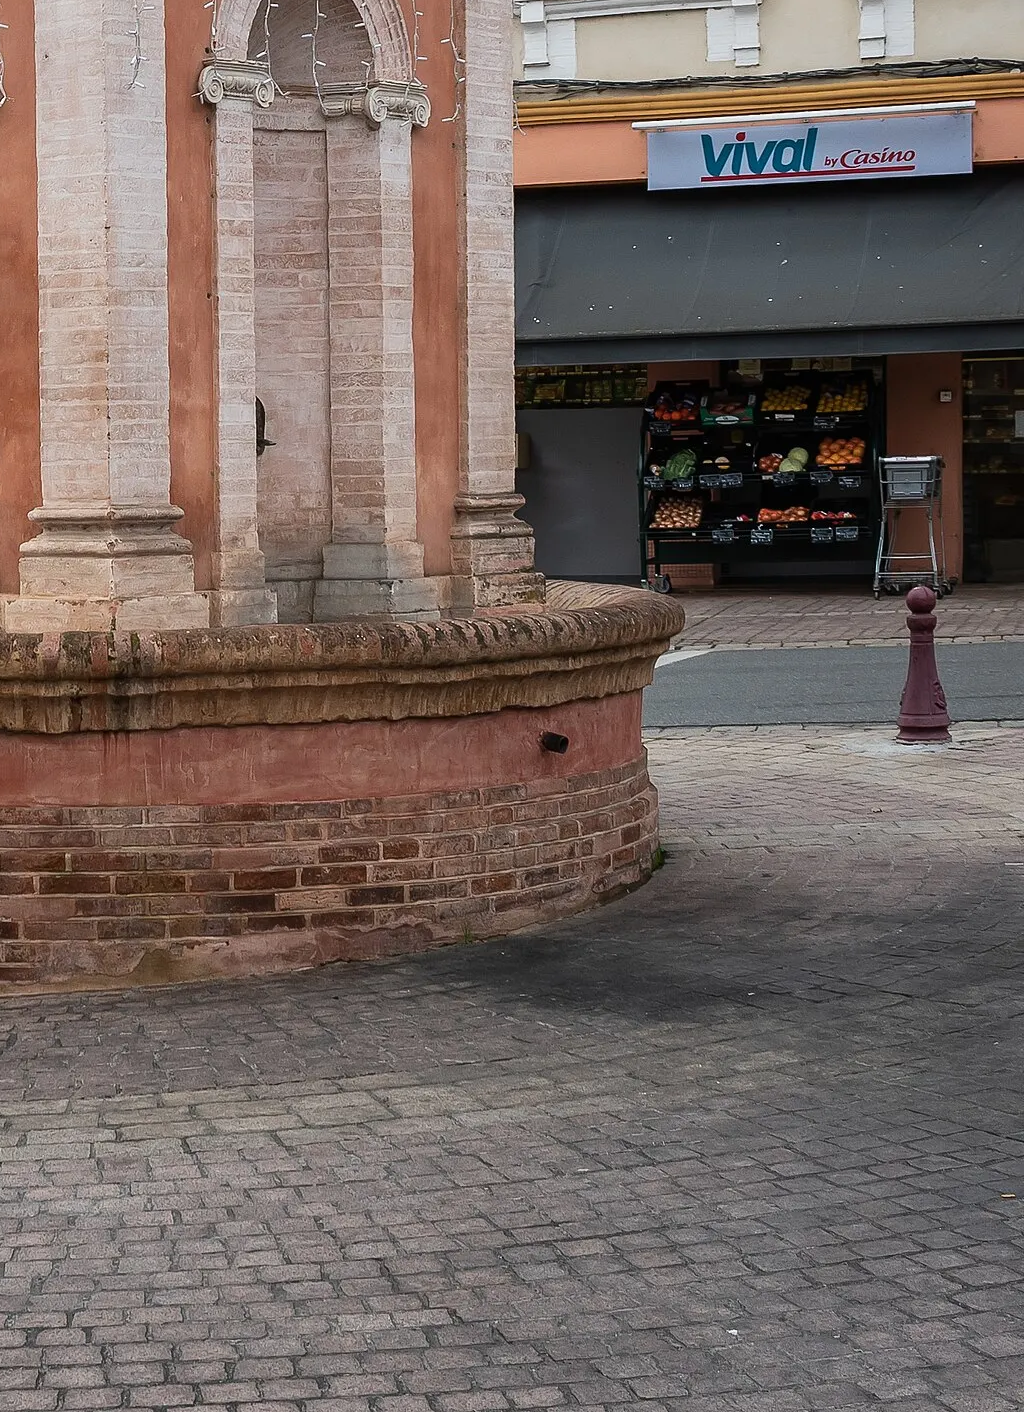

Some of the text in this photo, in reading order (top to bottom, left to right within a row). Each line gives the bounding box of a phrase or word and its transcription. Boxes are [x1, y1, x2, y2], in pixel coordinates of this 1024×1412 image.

[701, 127, 916, 176] Vival by Casino
